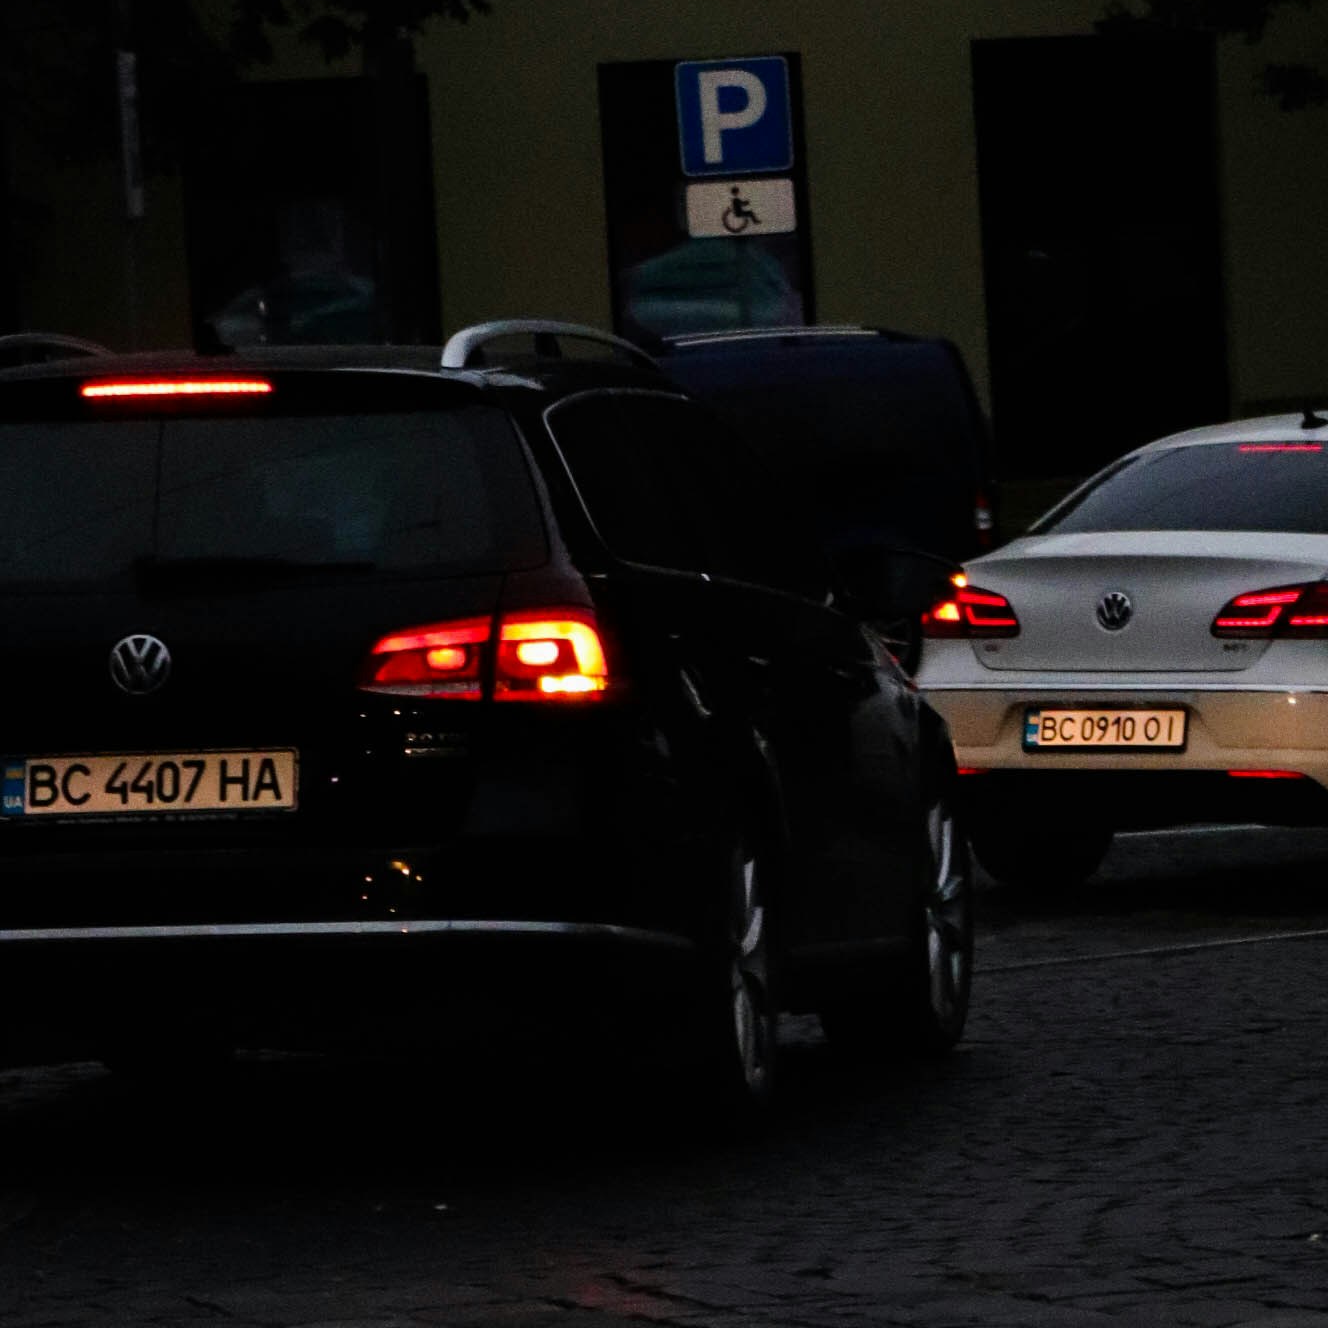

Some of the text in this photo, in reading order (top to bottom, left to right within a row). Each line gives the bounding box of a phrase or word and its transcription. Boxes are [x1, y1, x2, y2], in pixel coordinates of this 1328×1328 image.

[697, 68, 768, 165] P
[1040, 716, 1076, 741] BC
[1080, 715, 1136, 742] 0910
[29, 758, 282, 807] BC 4407 HA
